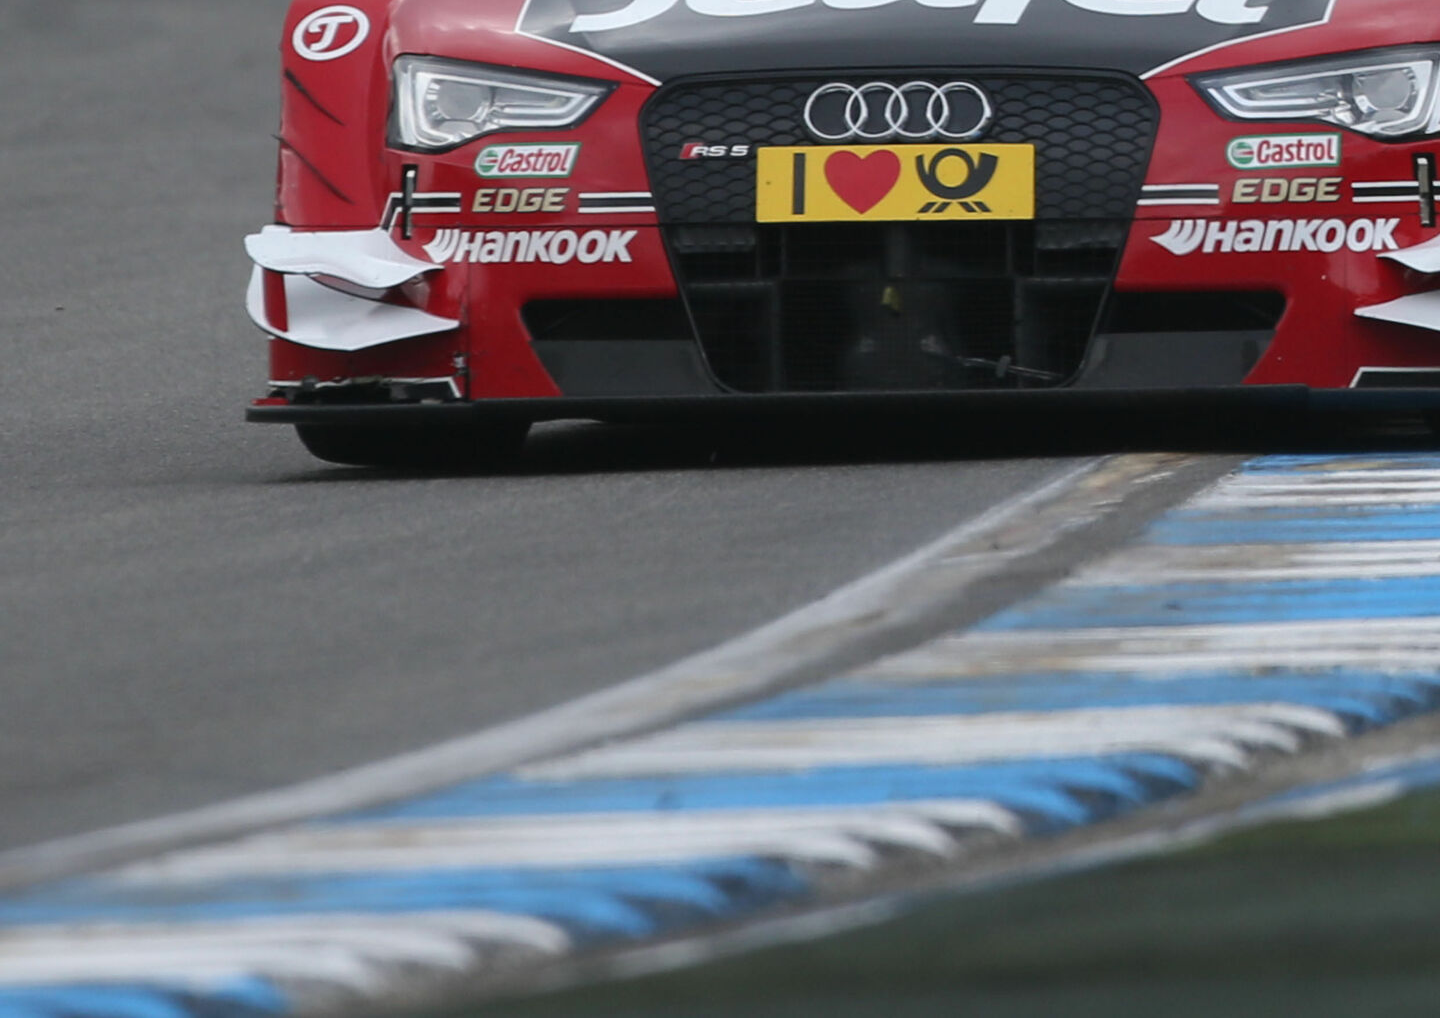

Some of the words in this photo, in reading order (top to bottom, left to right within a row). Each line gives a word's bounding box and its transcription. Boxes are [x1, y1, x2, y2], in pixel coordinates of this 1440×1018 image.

[497, 147, 574, 173] Castrol
[692, 144, 725, 158] RS
[1256, 138, 1336, 165] Castrol
[472, 188, 571, 213] EDGE
[1232, 177, 1344, 204] EDGE
